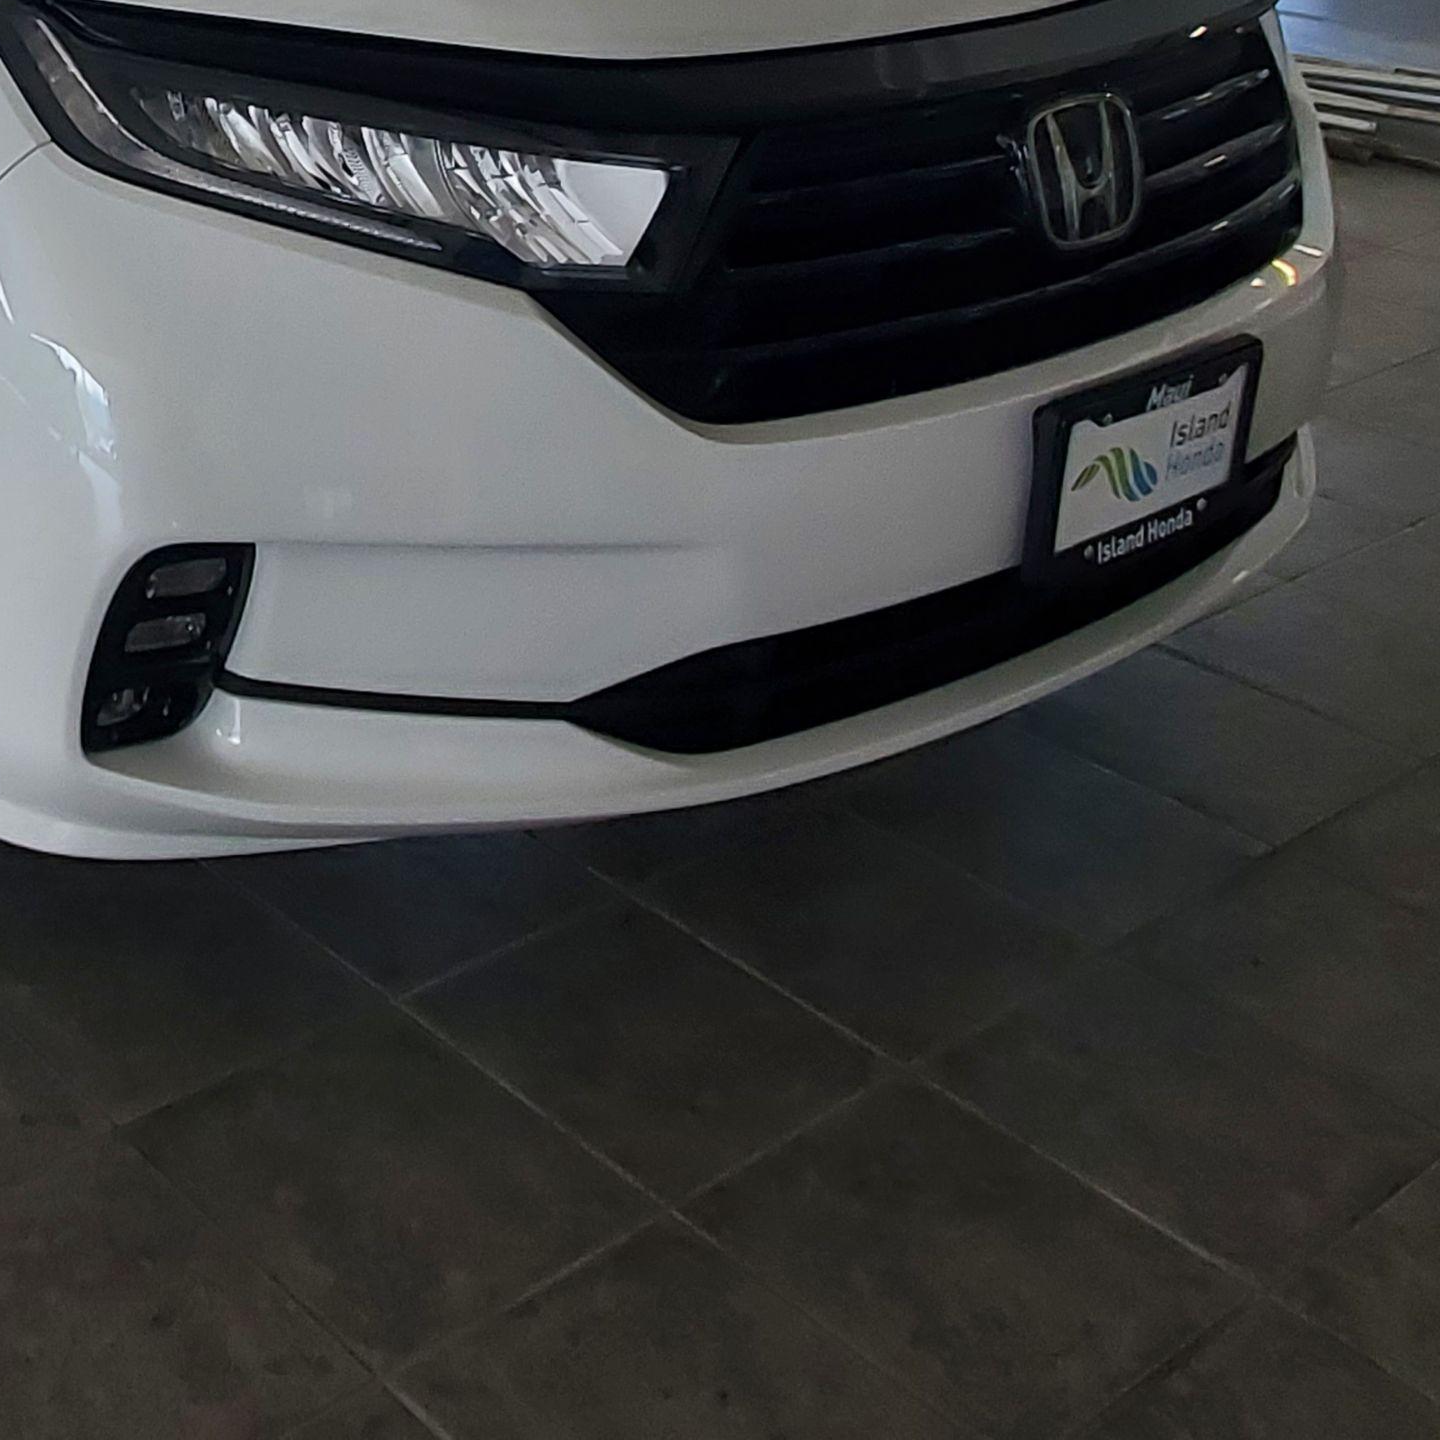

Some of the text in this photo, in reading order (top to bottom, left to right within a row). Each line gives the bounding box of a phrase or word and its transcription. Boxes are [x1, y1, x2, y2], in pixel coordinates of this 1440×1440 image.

[1146, 374, 1195, 411] Maui
[1169, 401, 1232, 447] Island
[1097, 507, 1193, 564] Island Honda
